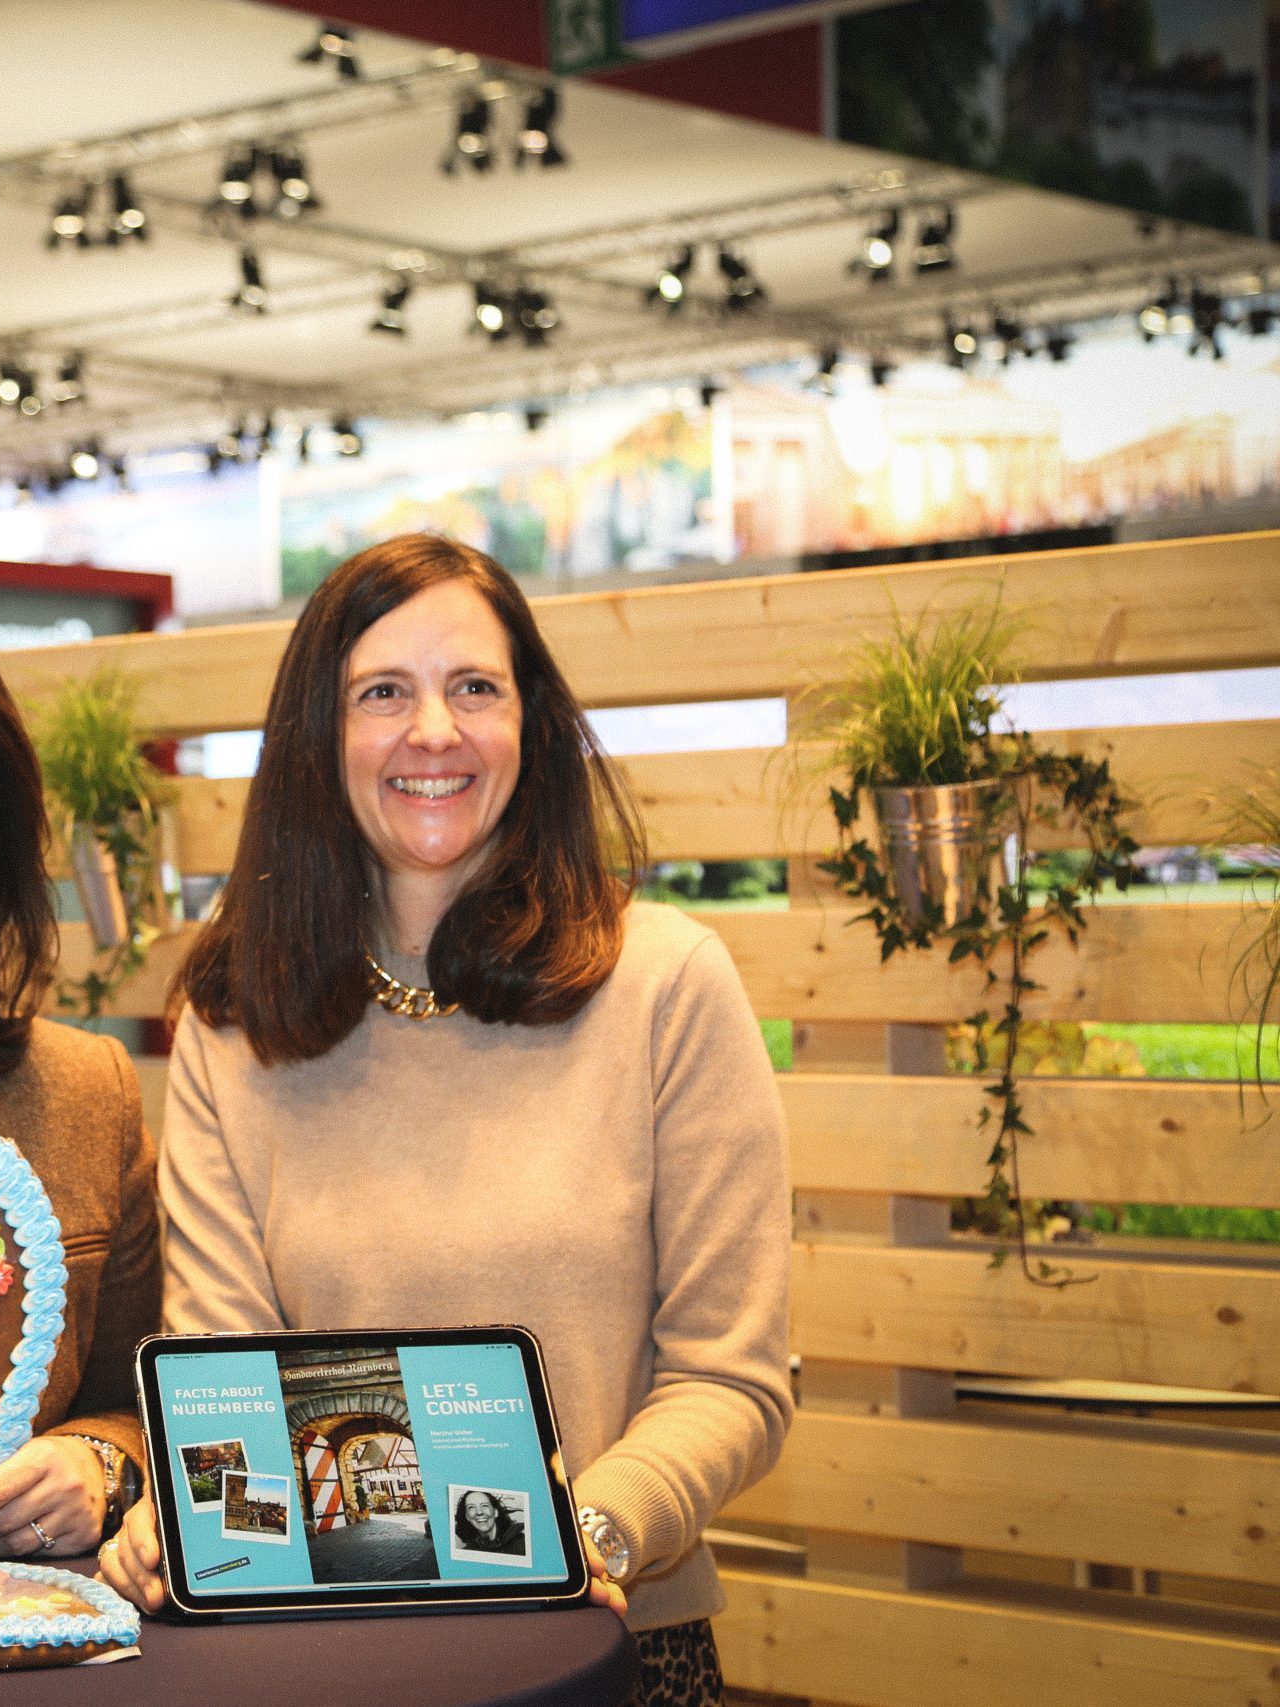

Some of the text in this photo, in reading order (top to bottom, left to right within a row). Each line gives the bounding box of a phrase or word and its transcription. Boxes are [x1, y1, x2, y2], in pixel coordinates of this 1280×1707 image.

[174, 1386, 265, 1399] FACTS ABOUT
[172, 1401, 276, 1416] NUREMBERG
[426, 1398, 525, 1416] CONNECT!
